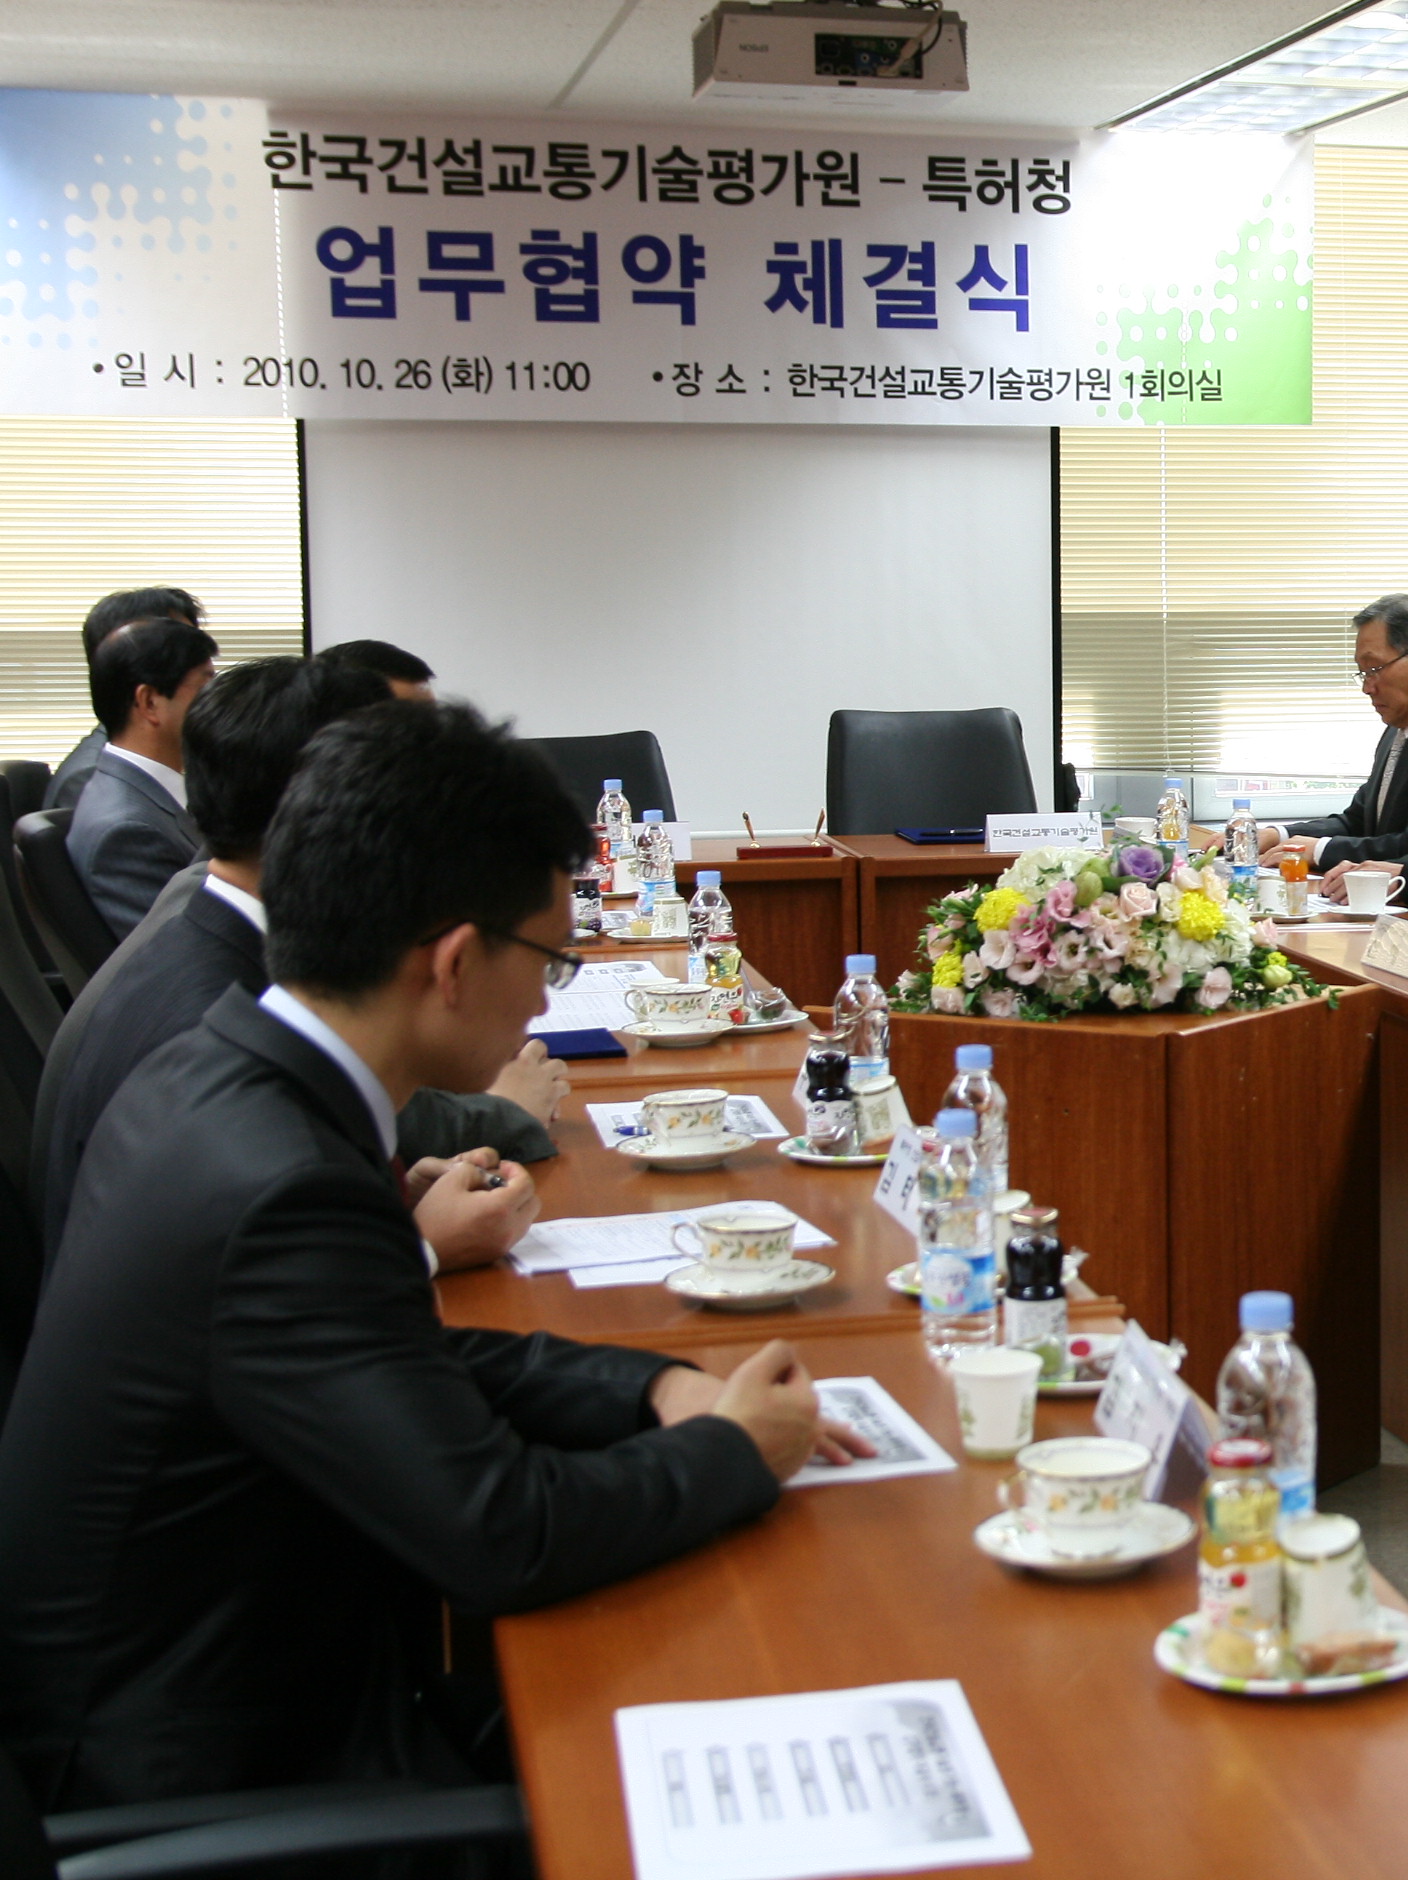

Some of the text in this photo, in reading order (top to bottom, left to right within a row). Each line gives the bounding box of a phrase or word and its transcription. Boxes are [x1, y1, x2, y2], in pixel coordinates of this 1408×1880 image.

[262, 130, 861, 210] 한국건설교통기술평가원
[922, 155, 1073, 216] 특허청
[316, 226, 1030, 332] 업무협약 체결식
[242, 355, 327, 391] 2010.
[340, 358, 385, 391] 10.
[394, 358, 433, 391] 26
[441, 355, 494, 395] (화)
[505, 361, 591, 392] 11:00
[787, 363, 1112, 402] 한국건설교통기술평가원
[1123, 367, 1224, 403] 1회의실
